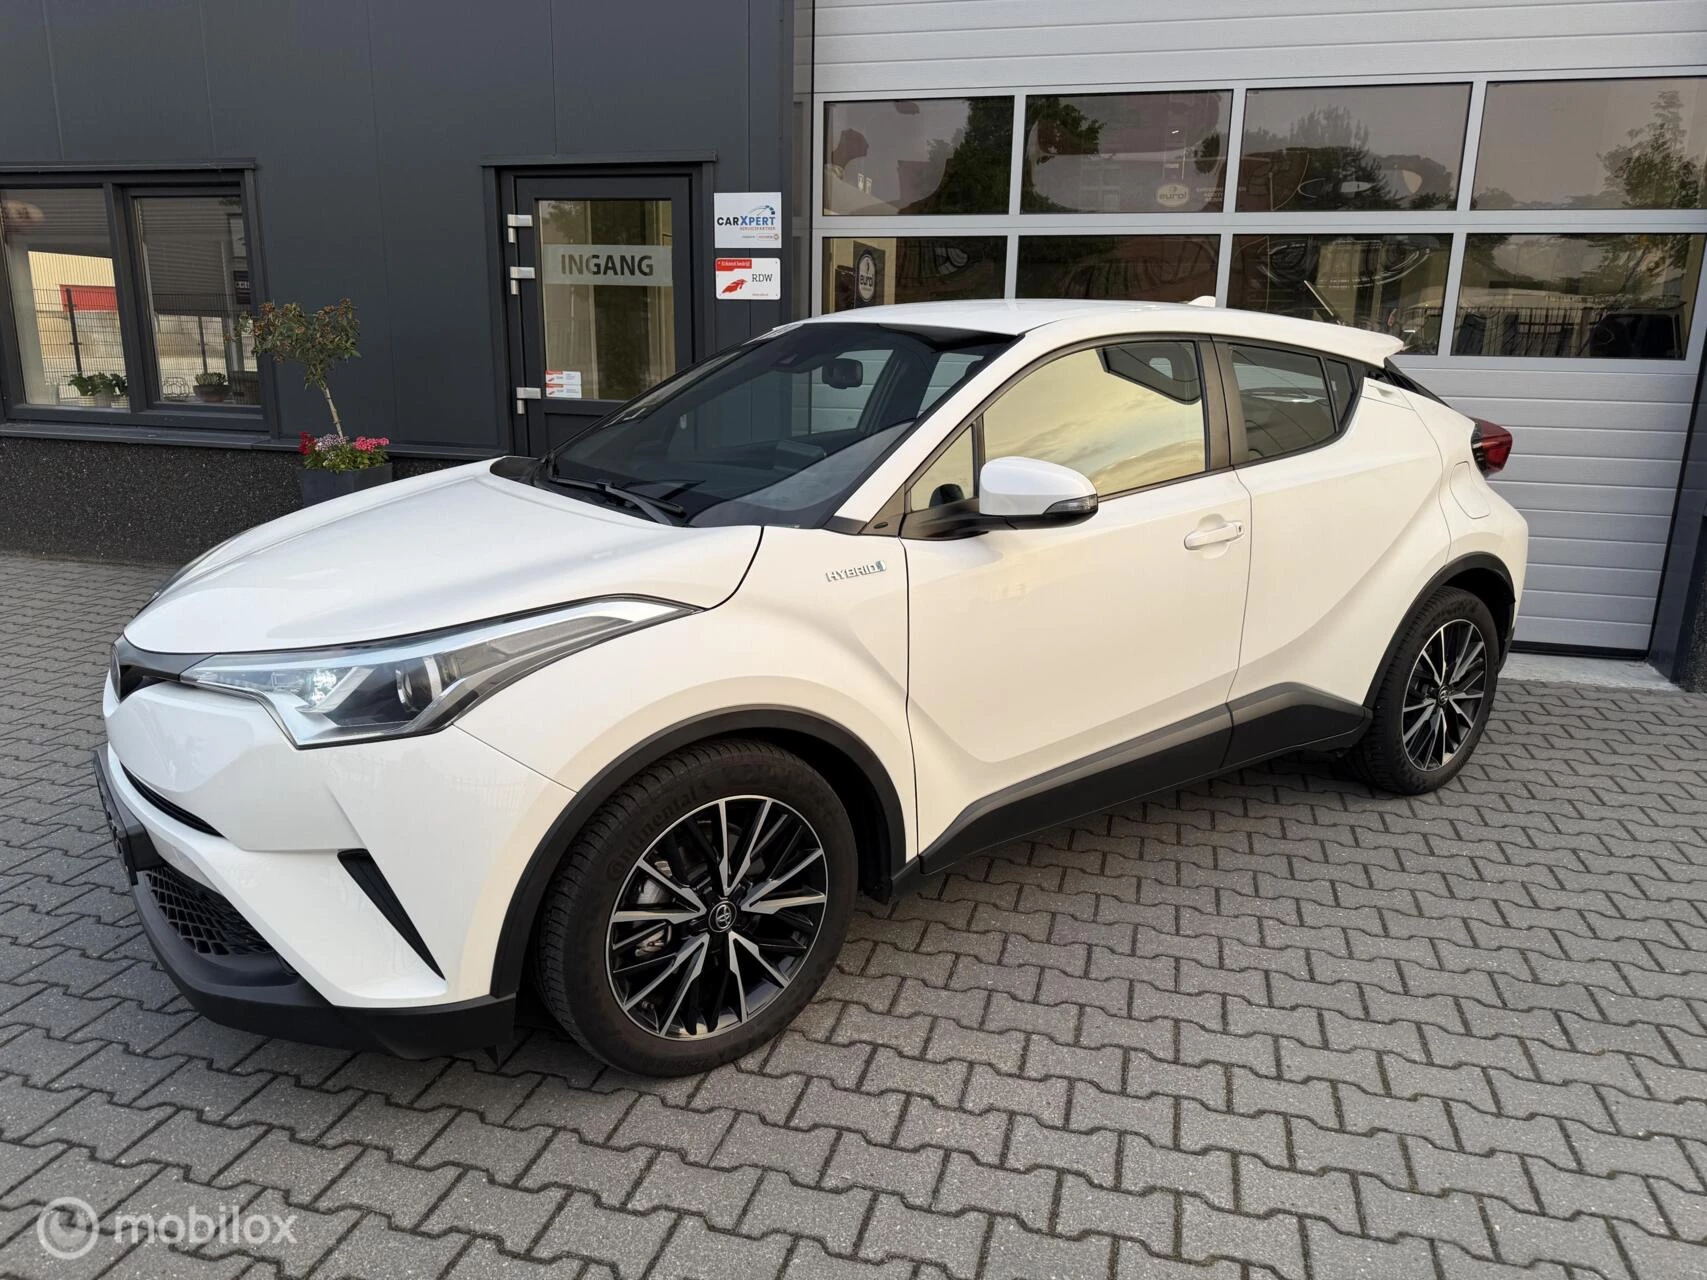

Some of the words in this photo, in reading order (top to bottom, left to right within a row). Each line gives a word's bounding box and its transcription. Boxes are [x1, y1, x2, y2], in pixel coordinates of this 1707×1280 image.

[717, 216, 776, 226] CARXPERT
[561, 254, 654, 277] INGANG
[752, 273, 773, 283] RDW
[825, 564, 879, 582] HYBRID
